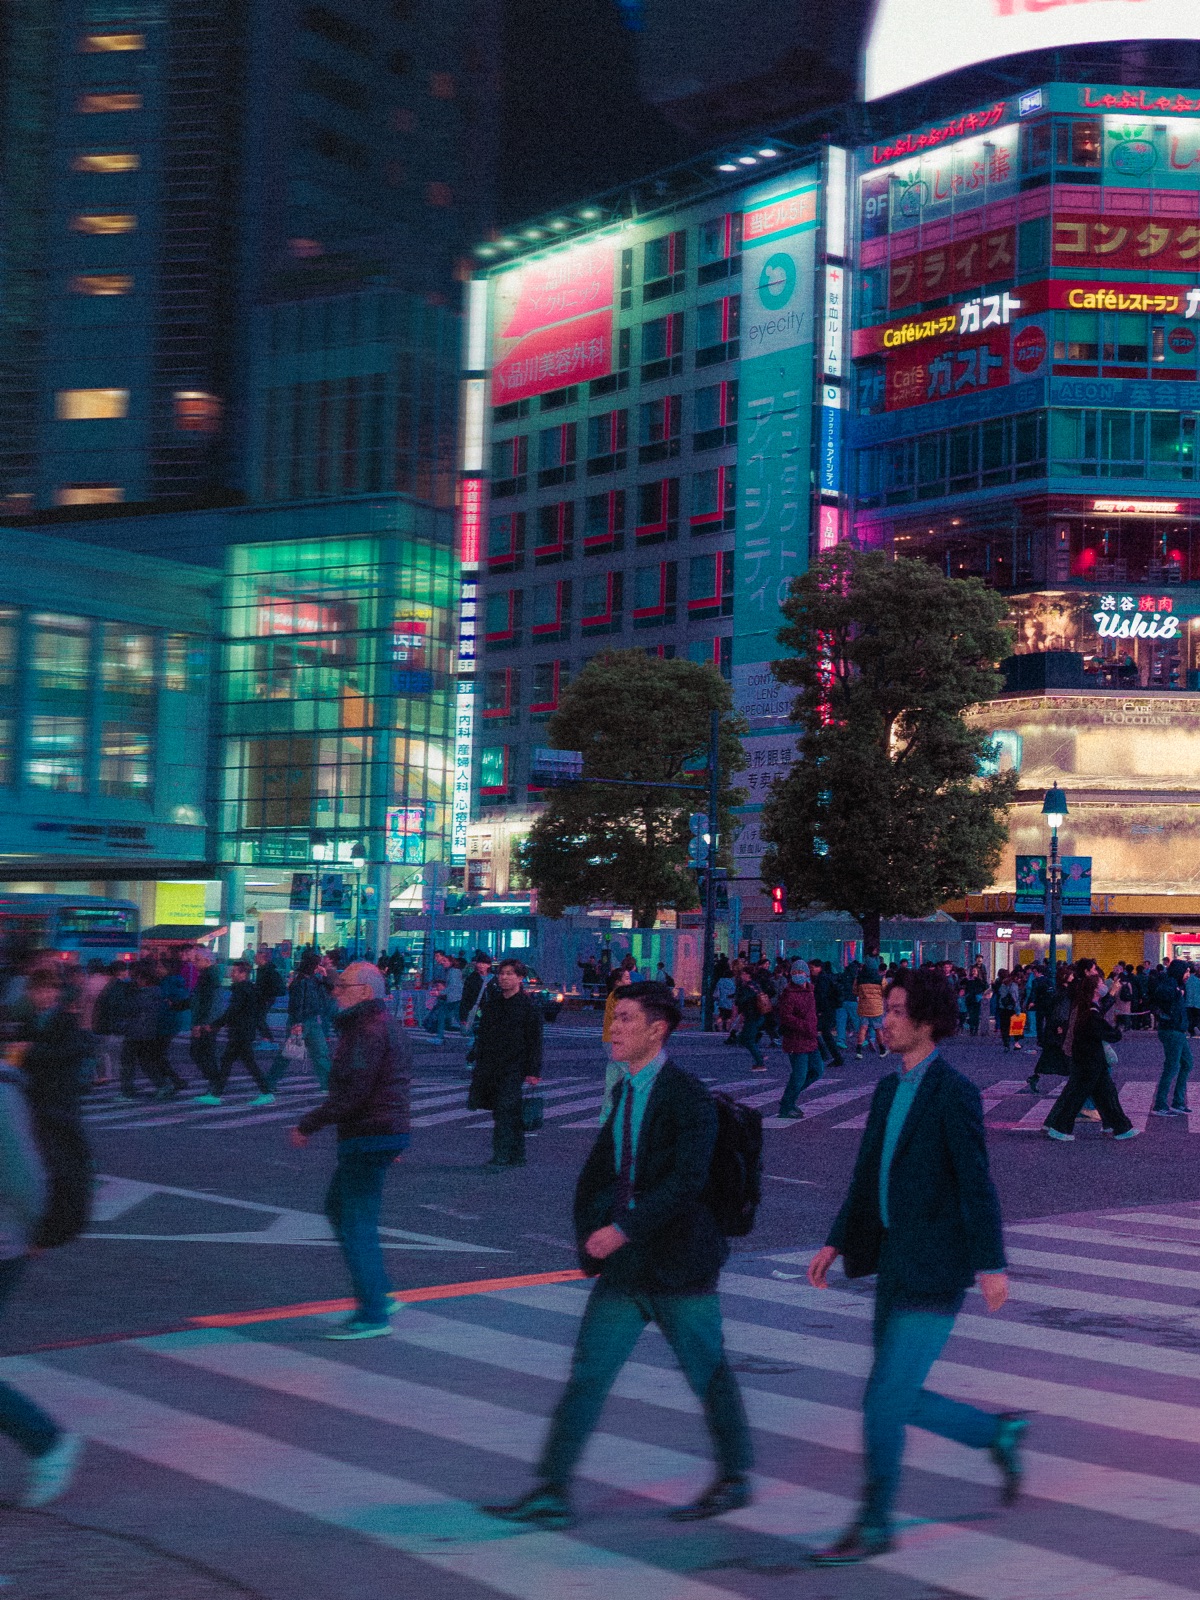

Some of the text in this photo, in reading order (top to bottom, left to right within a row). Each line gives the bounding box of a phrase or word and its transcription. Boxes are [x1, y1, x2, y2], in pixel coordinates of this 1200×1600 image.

[872, 102, 1006, 164] しゃぶしゃぶバイキング
[865, 194, 888, 219] 9F
[891, 233, 1013, 298] プライス
[959, 291, 1021, 335] ガスト
[749, 310, 805, 344] eyecity
[507, 336, 605, 390] 品川美容外科
[926, 345, 1003, 400] ガスト
[859, 374, 886, 401] 7F
[1060, 383, 1115, 400] AEON
[1093, 612, 1180, 638] Ushi8
[748, 673, 778, 687] CONTA
[756, 688, 779, 701] LENS
[458, 715, 471, 739] 内科
